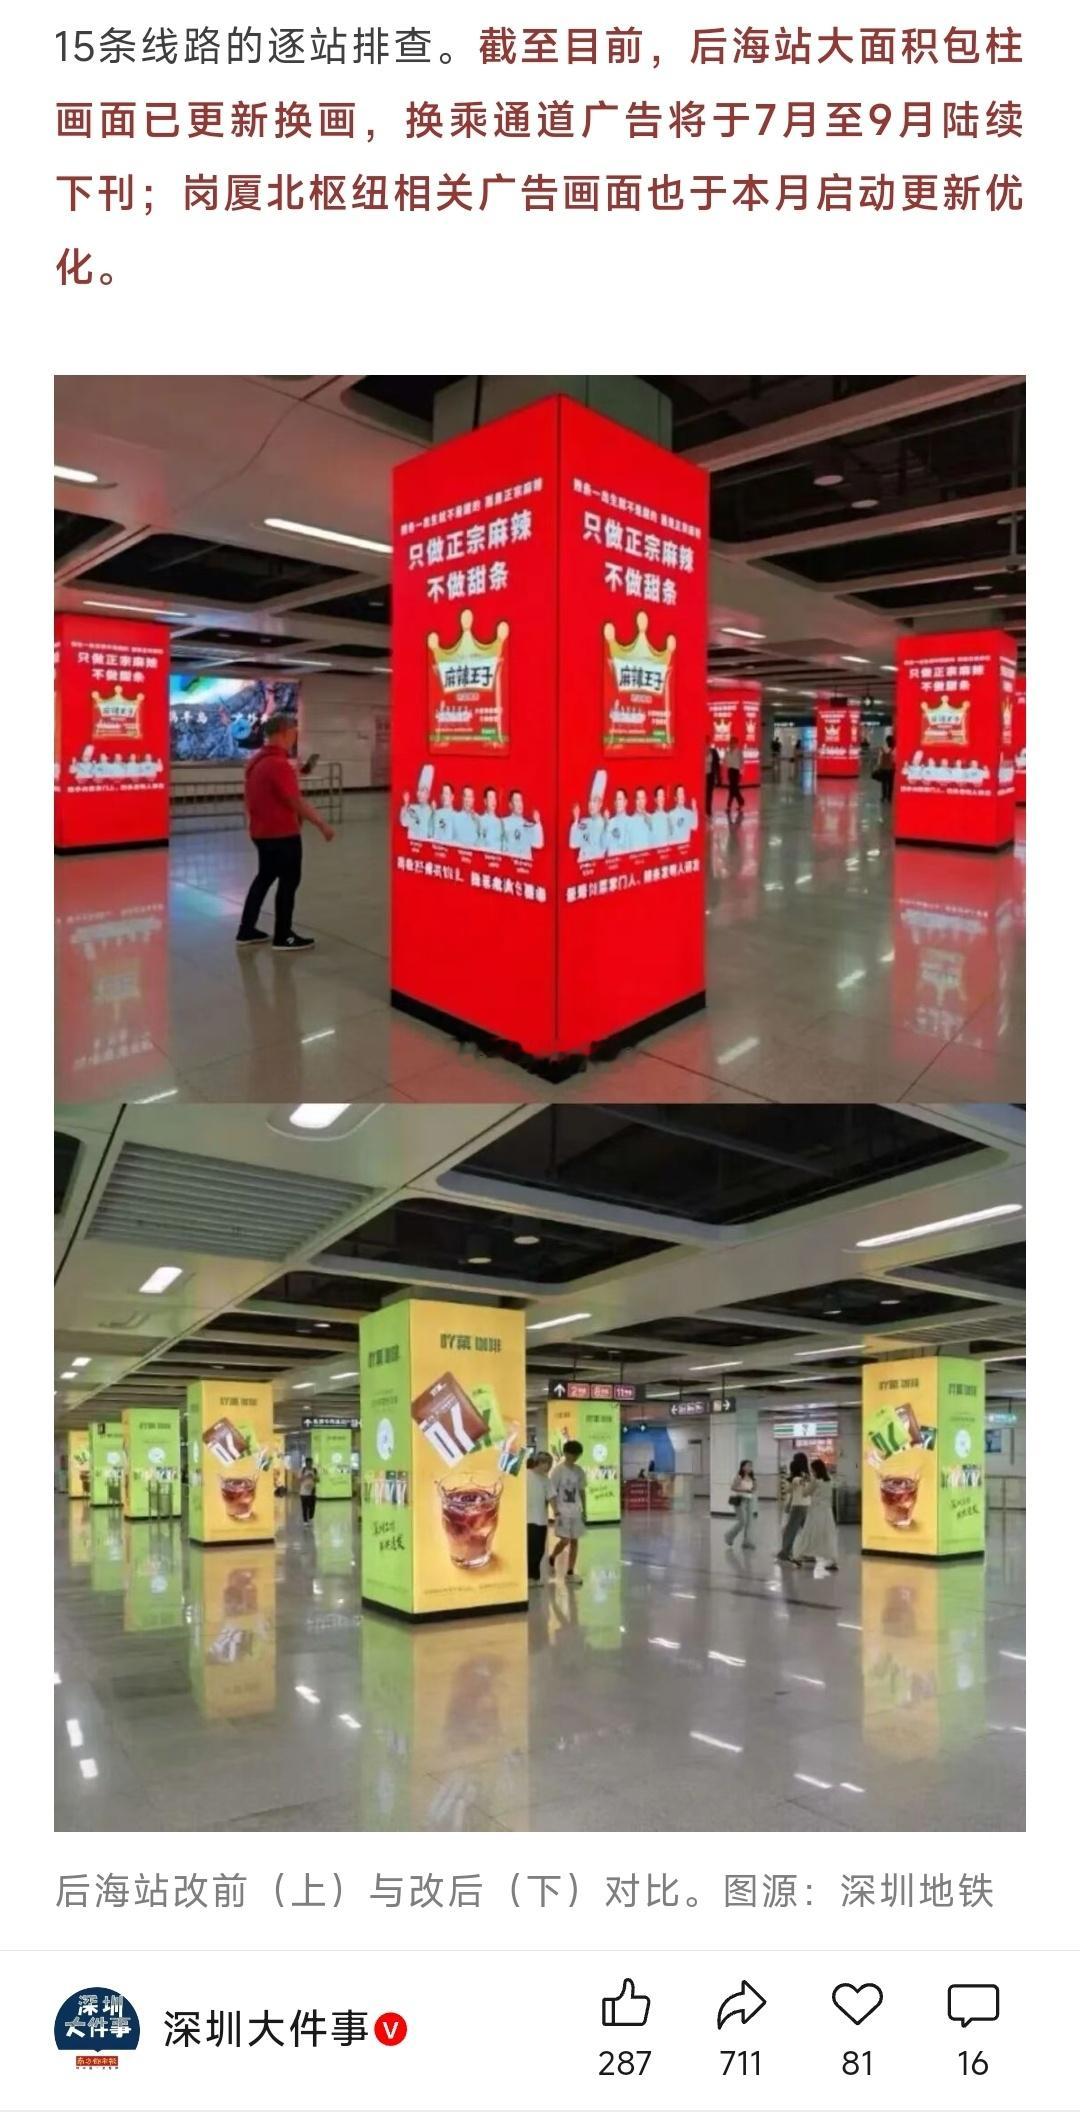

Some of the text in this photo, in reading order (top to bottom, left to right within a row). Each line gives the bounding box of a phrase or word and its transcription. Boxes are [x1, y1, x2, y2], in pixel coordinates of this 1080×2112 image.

[408, 509, 532, 570] 只做正宗麻辣
[583, 510, 694, 573] 只做正宗麻辣
[427, 561, 509, 603] 不做甜条
[605, 561, 677, 606] 不做甜条
[445, 666, 493, 688] 麻辣王子
[619, 665, 663, 690] 麻辣王子
